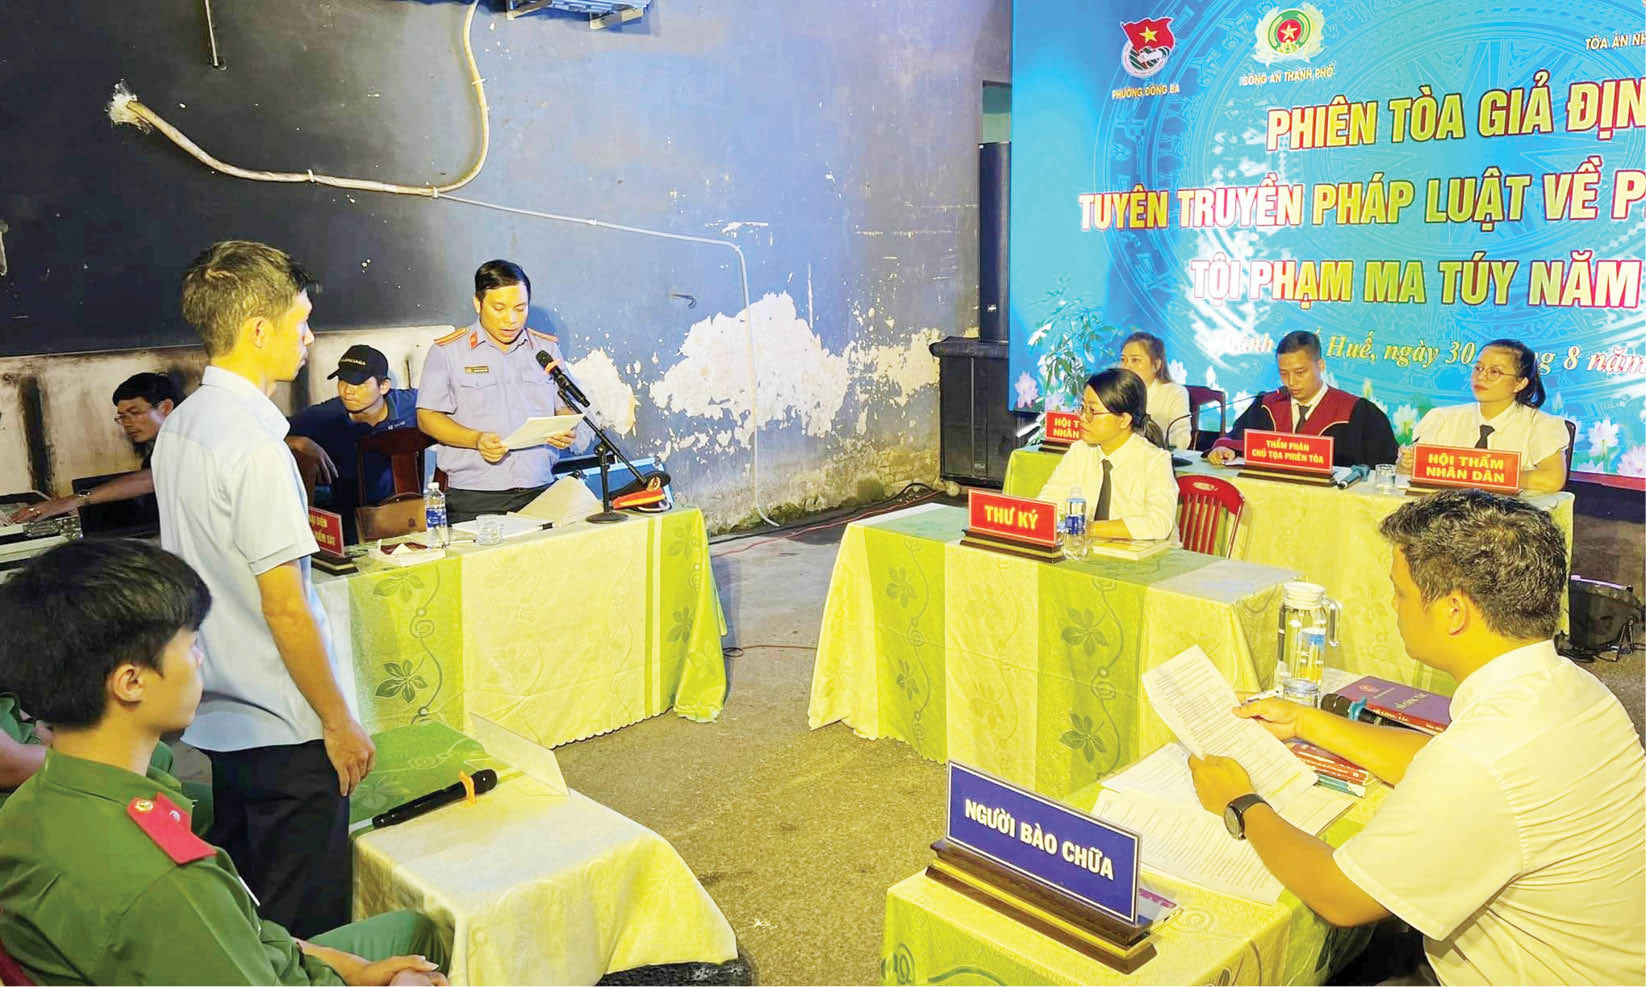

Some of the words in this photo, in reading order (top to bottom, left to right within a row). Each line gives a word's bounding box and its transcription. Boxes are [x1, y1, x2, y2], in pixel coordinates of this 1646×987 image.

[1270, 71, 1282, 83] AN
[1169, 82, 1180, 94] BA
[1267, 95, 1378, 151] PHIÊN
[1388, 84, 1466, 143] TÒA
[1478, 69, 1554, 137] GIẢ
[1079, 183, 1169, 231] TUYÊN
[1177, 172, 1303, 228] TRUYỀN
[1312, 172, 1415, 225] PHÁP
[1425, 166, 1532, 232] LUẬT
[1542, 155, 1602, 221] VỀ
[1191, 251, 1241, 306] TỘI
[1249, 259, 1354, 310] PHẠM
[1363, 260, 1427, 304] MA
[1438, 250, 1519, 305] TÚY
[1527, 250, 1642, 309] NĂM
[1326, 330, 1376, 362] Huế,
[1384, 340, 1439, 368] ngày
[1445, 341, 1476, 365] 30
[1563, 345, 1581, 371] 8
[1054, 416, 1072, 429] HỘI
[1053, 428, 1080, 439] NHÂN
[1266, 437, 1287, 449] THẨM
[1289, 441, 1310, 452] PHÁN
[1284, 451, 1307, 462] PHIÊN
[1309, 453, 1324, 464] TÒA
[1428, 453, 1455, 466] HỘI
[1459, 454, 1504, 470] THẨM
[1426, 466, 1467, 480] NHÂN
[1472, 469, 1504, 483] DÂN
[984, 504, 1015, 526] THƯ
[1018, 508, 1038, 530] KÝ
[965, 798, 1016, 838] NGƯỜI
[1020, 822, 1058, 855] BÀO
[1062, 840, 1114, 881] CHỮA
